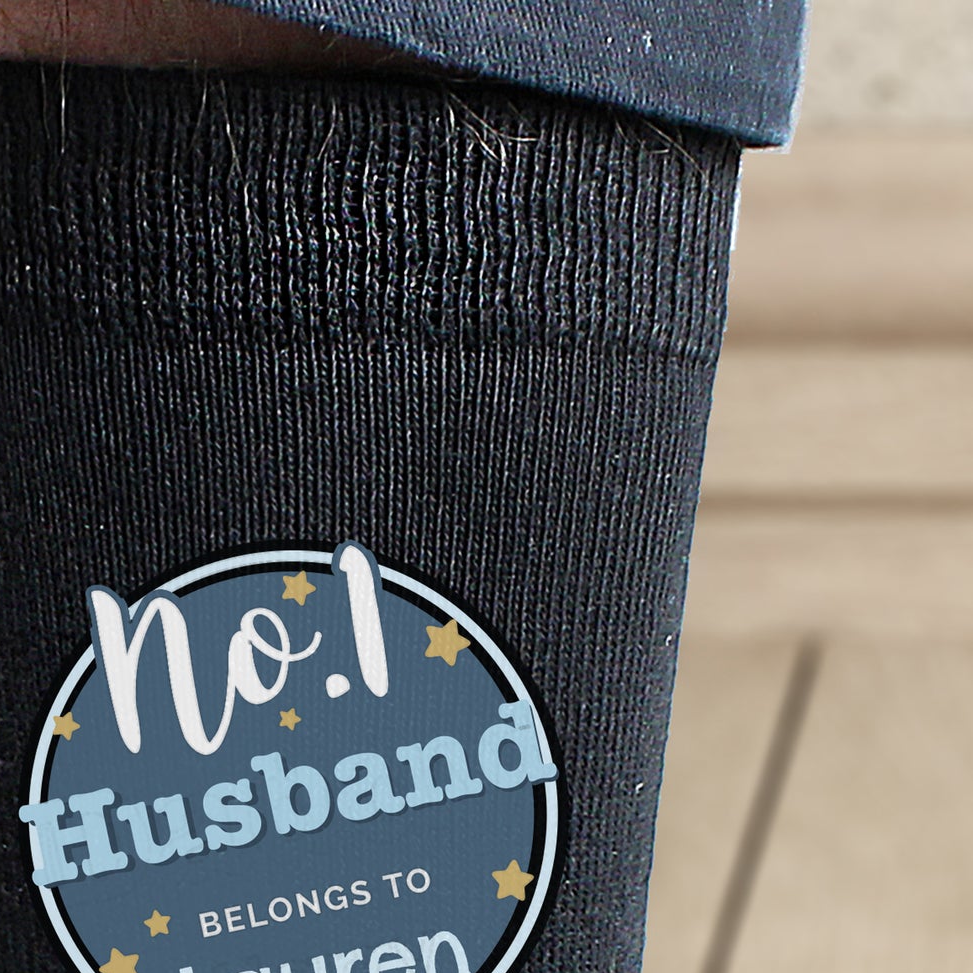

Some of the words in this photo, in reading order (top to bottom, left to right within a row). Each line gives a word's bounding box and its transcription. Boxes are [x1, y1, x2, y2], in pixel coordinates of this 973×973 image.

[19, 699, 558, 887] Husband
[198, 879, 373, 939] BELONGS
[381, 867, 432, 900] TO
